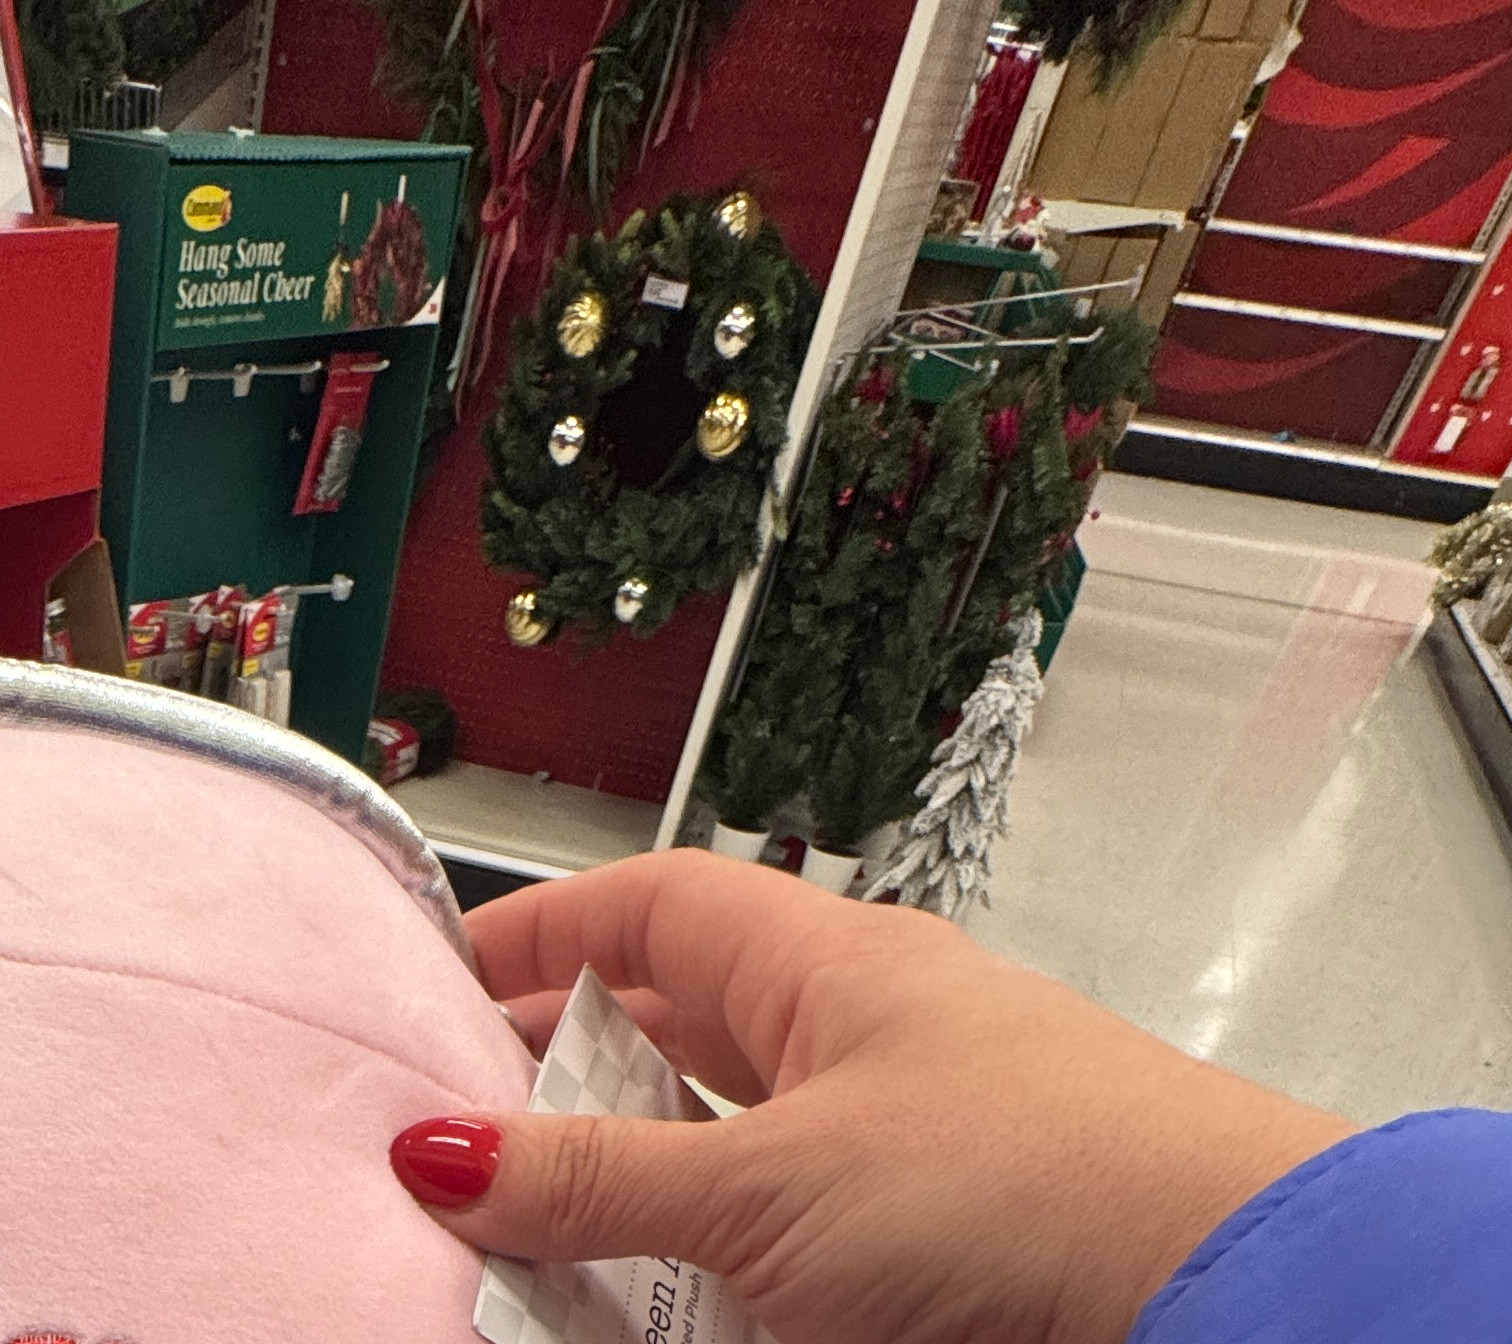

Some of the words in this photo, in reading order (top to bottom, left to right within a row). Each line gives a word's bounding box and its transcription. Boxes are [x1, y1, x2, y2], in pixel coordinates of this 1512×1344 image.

[178, 240, 232, 279] Hang
[234, 237, 286, 269] Some
[175, 271, 261, 310] Seasonal
[263, 270, 316, 303] Cheer
[683, 1272, 702, 1318] Plush
